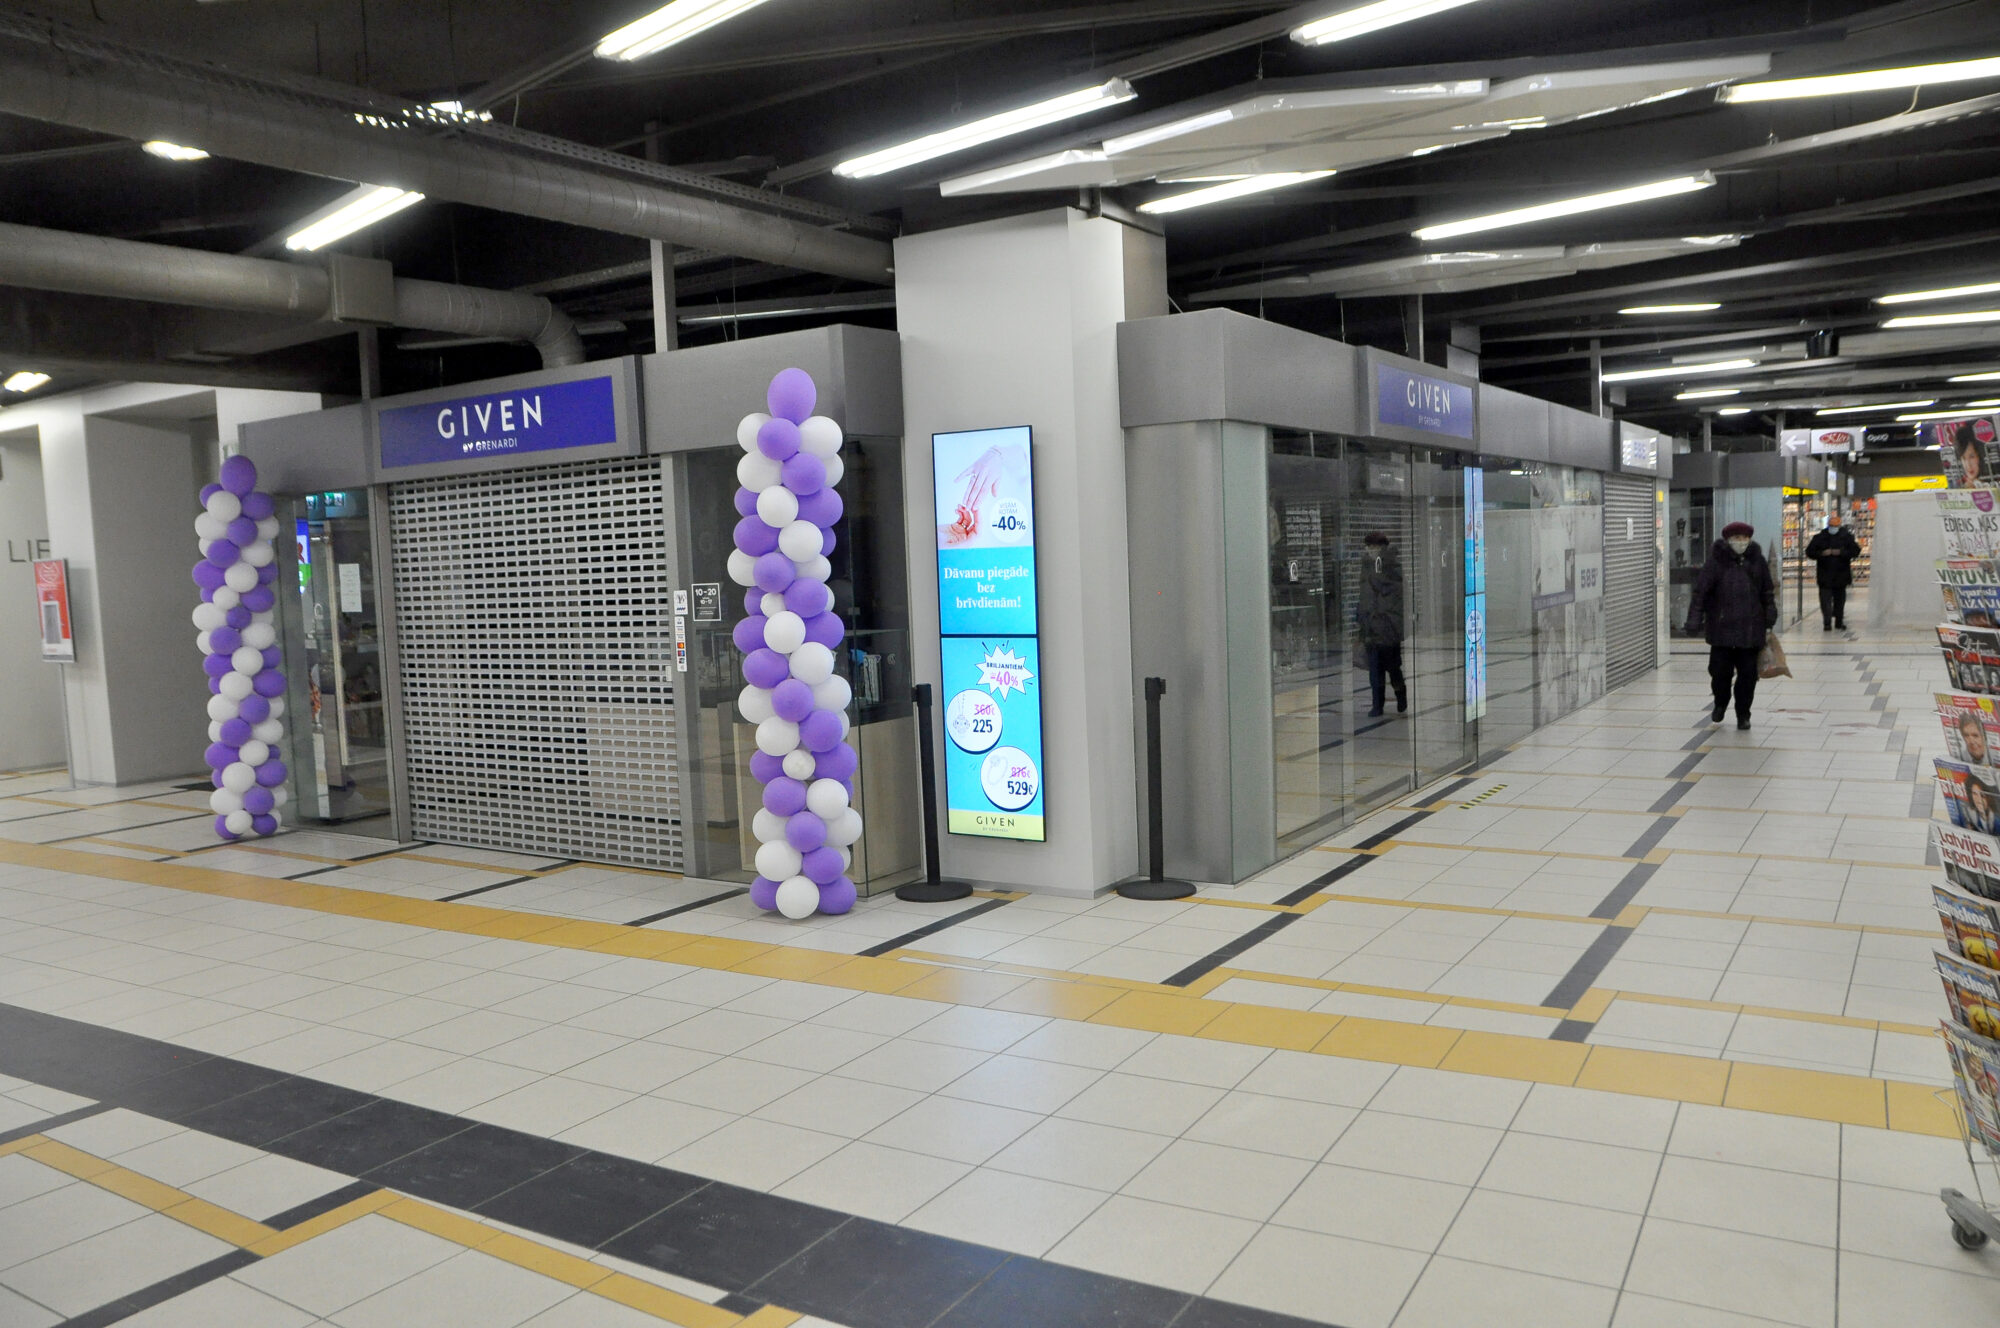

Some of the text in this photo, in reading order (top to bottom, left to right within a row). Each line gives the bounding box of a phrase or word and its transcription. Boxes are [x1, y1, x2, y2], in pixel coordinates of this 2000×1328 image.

[1407, 379, 1451, 415] GIVEN
[437, 395, 543, 439] GIVEN
[475, 437, 518, 452] GRENARDI
[991, 515, 1027, 531] -40%
[944, 565, 1030, 581] Dāvanu piegāde
[977, 582, 996, 593] bez
[956, 596, 1022, 609] brīvdienām!
[972, 718, 993, 733] 225
[975, 815, 1015, 827] GIVEN
[1937, 826, 1992, 858] Latvijas
